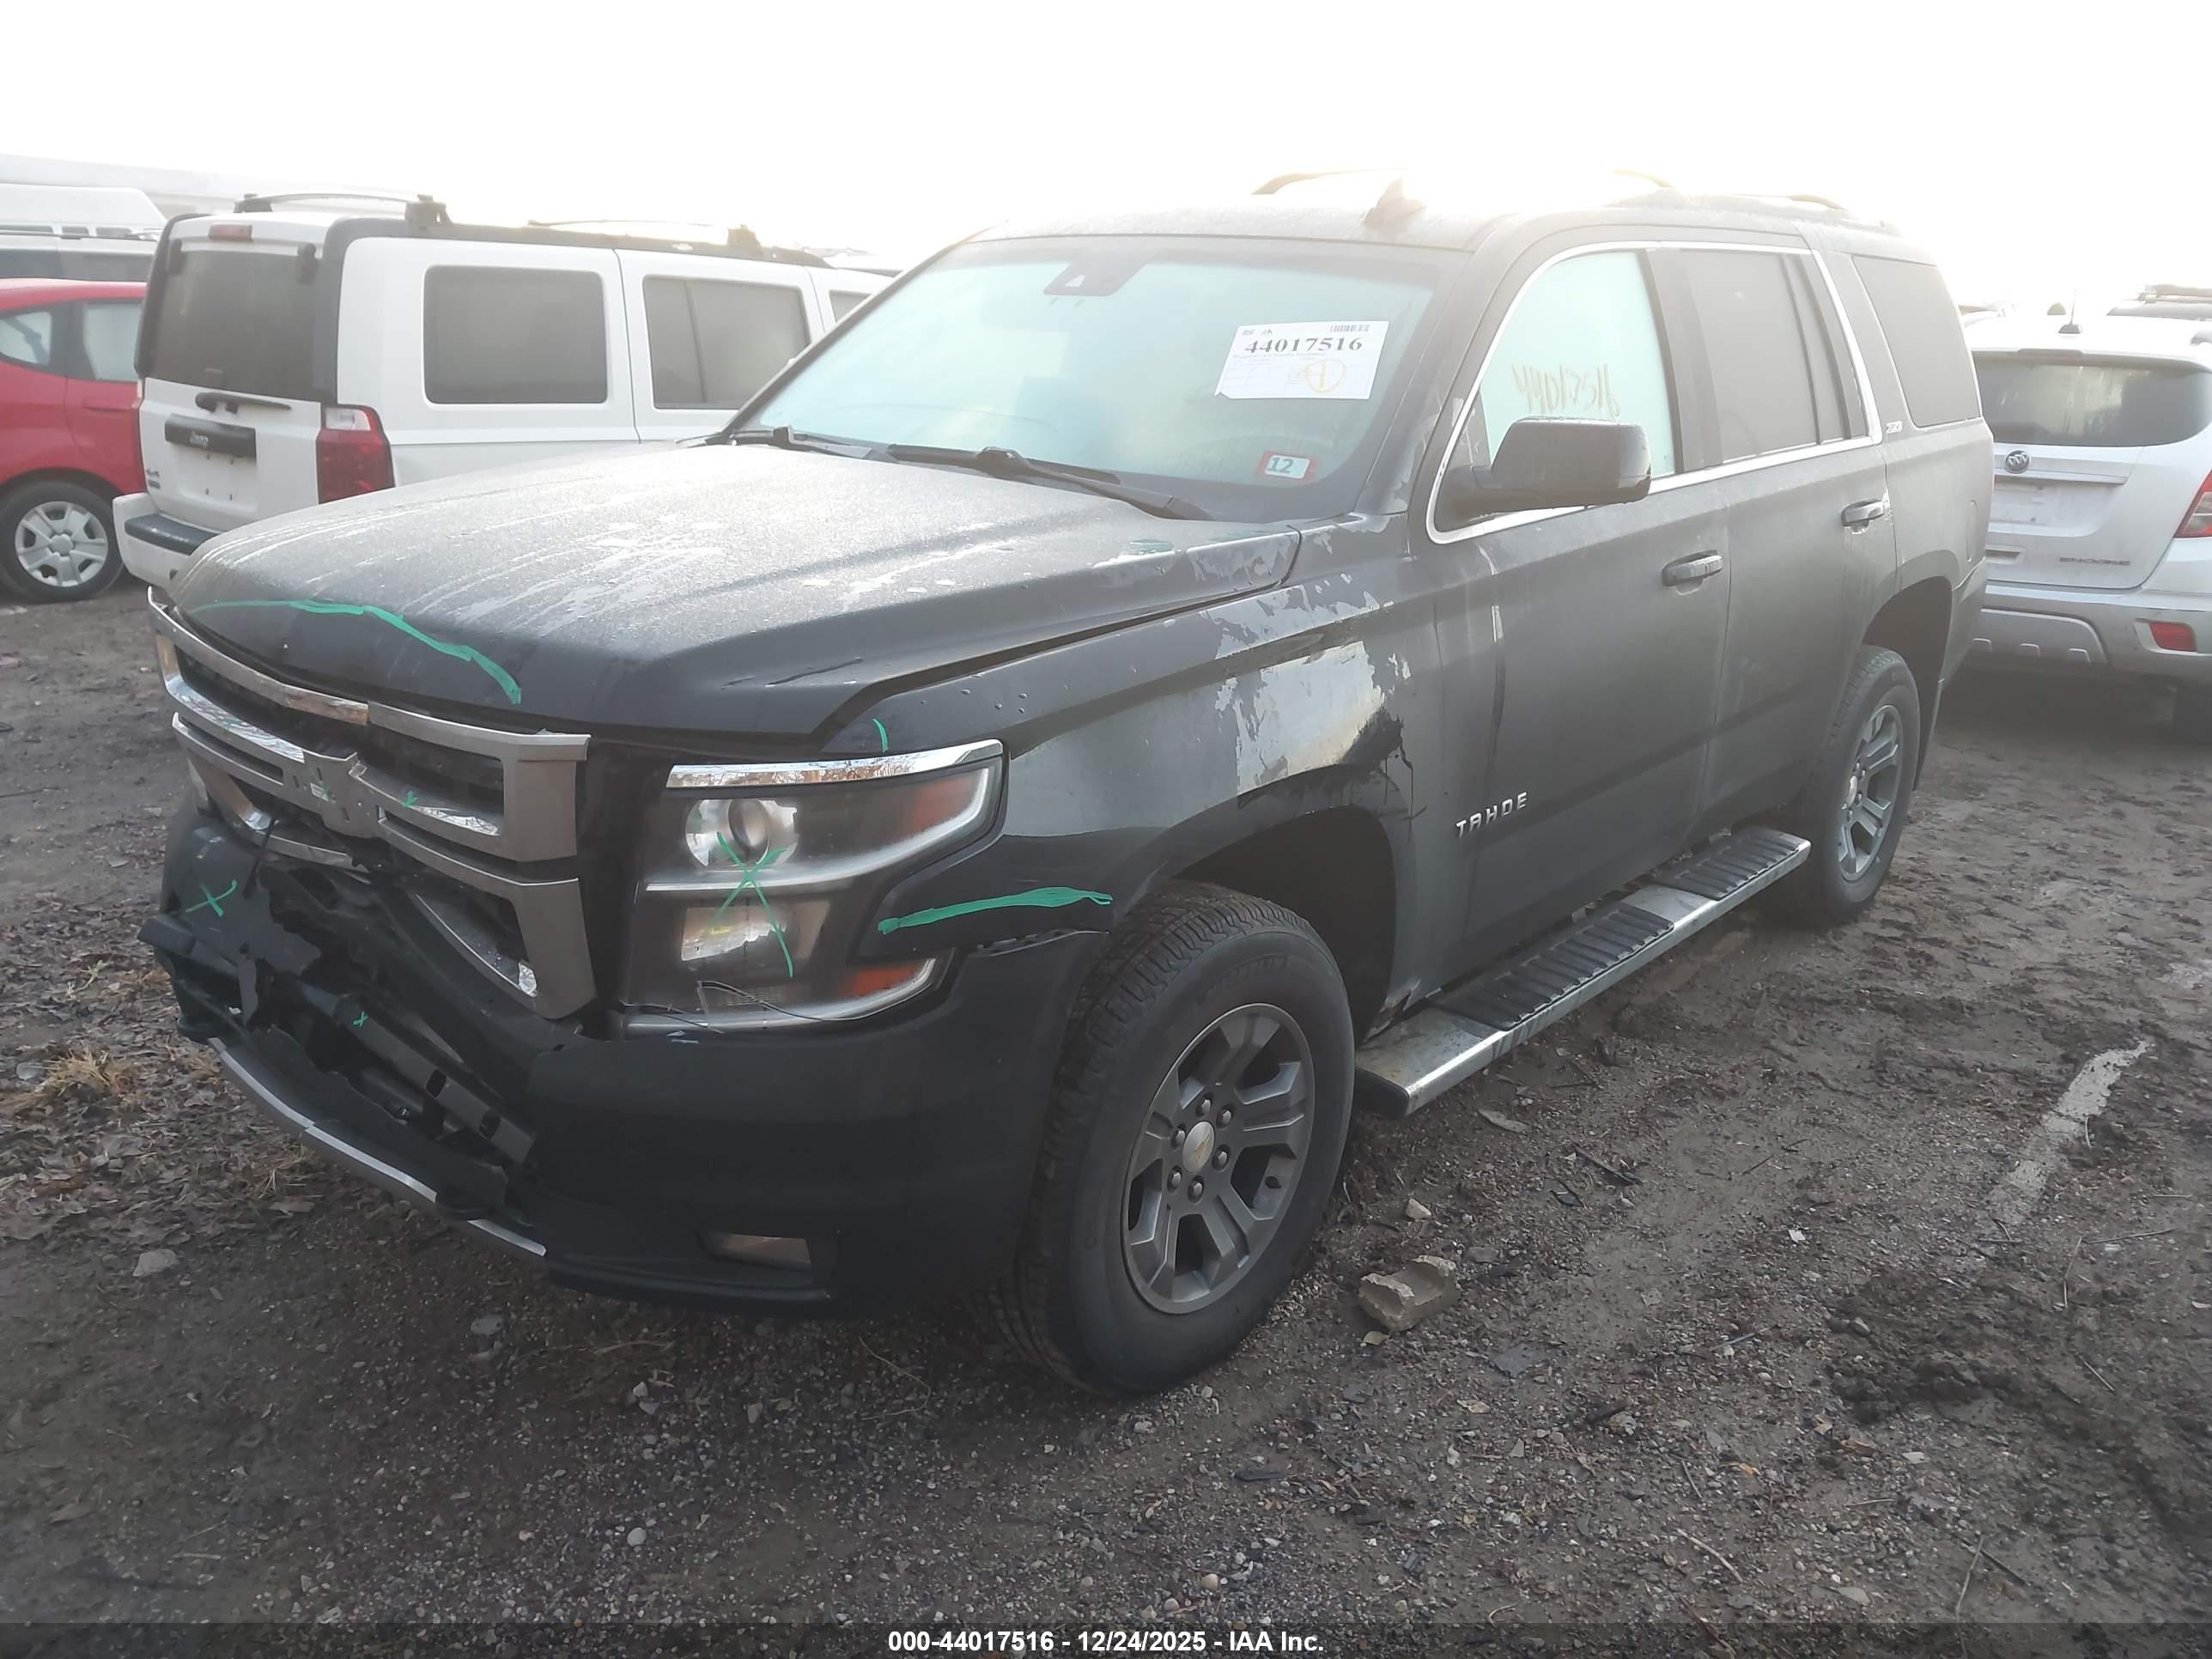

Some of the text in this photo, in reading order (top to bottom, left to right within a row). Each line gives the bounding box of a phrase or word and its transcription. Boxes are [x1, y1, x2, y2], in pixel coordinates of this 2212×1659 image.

[1244, 337, 1364, 354] 44017516
[1267, 456, 1294, 474] 12
[1455, 791, 1528, 839] TAHOE
